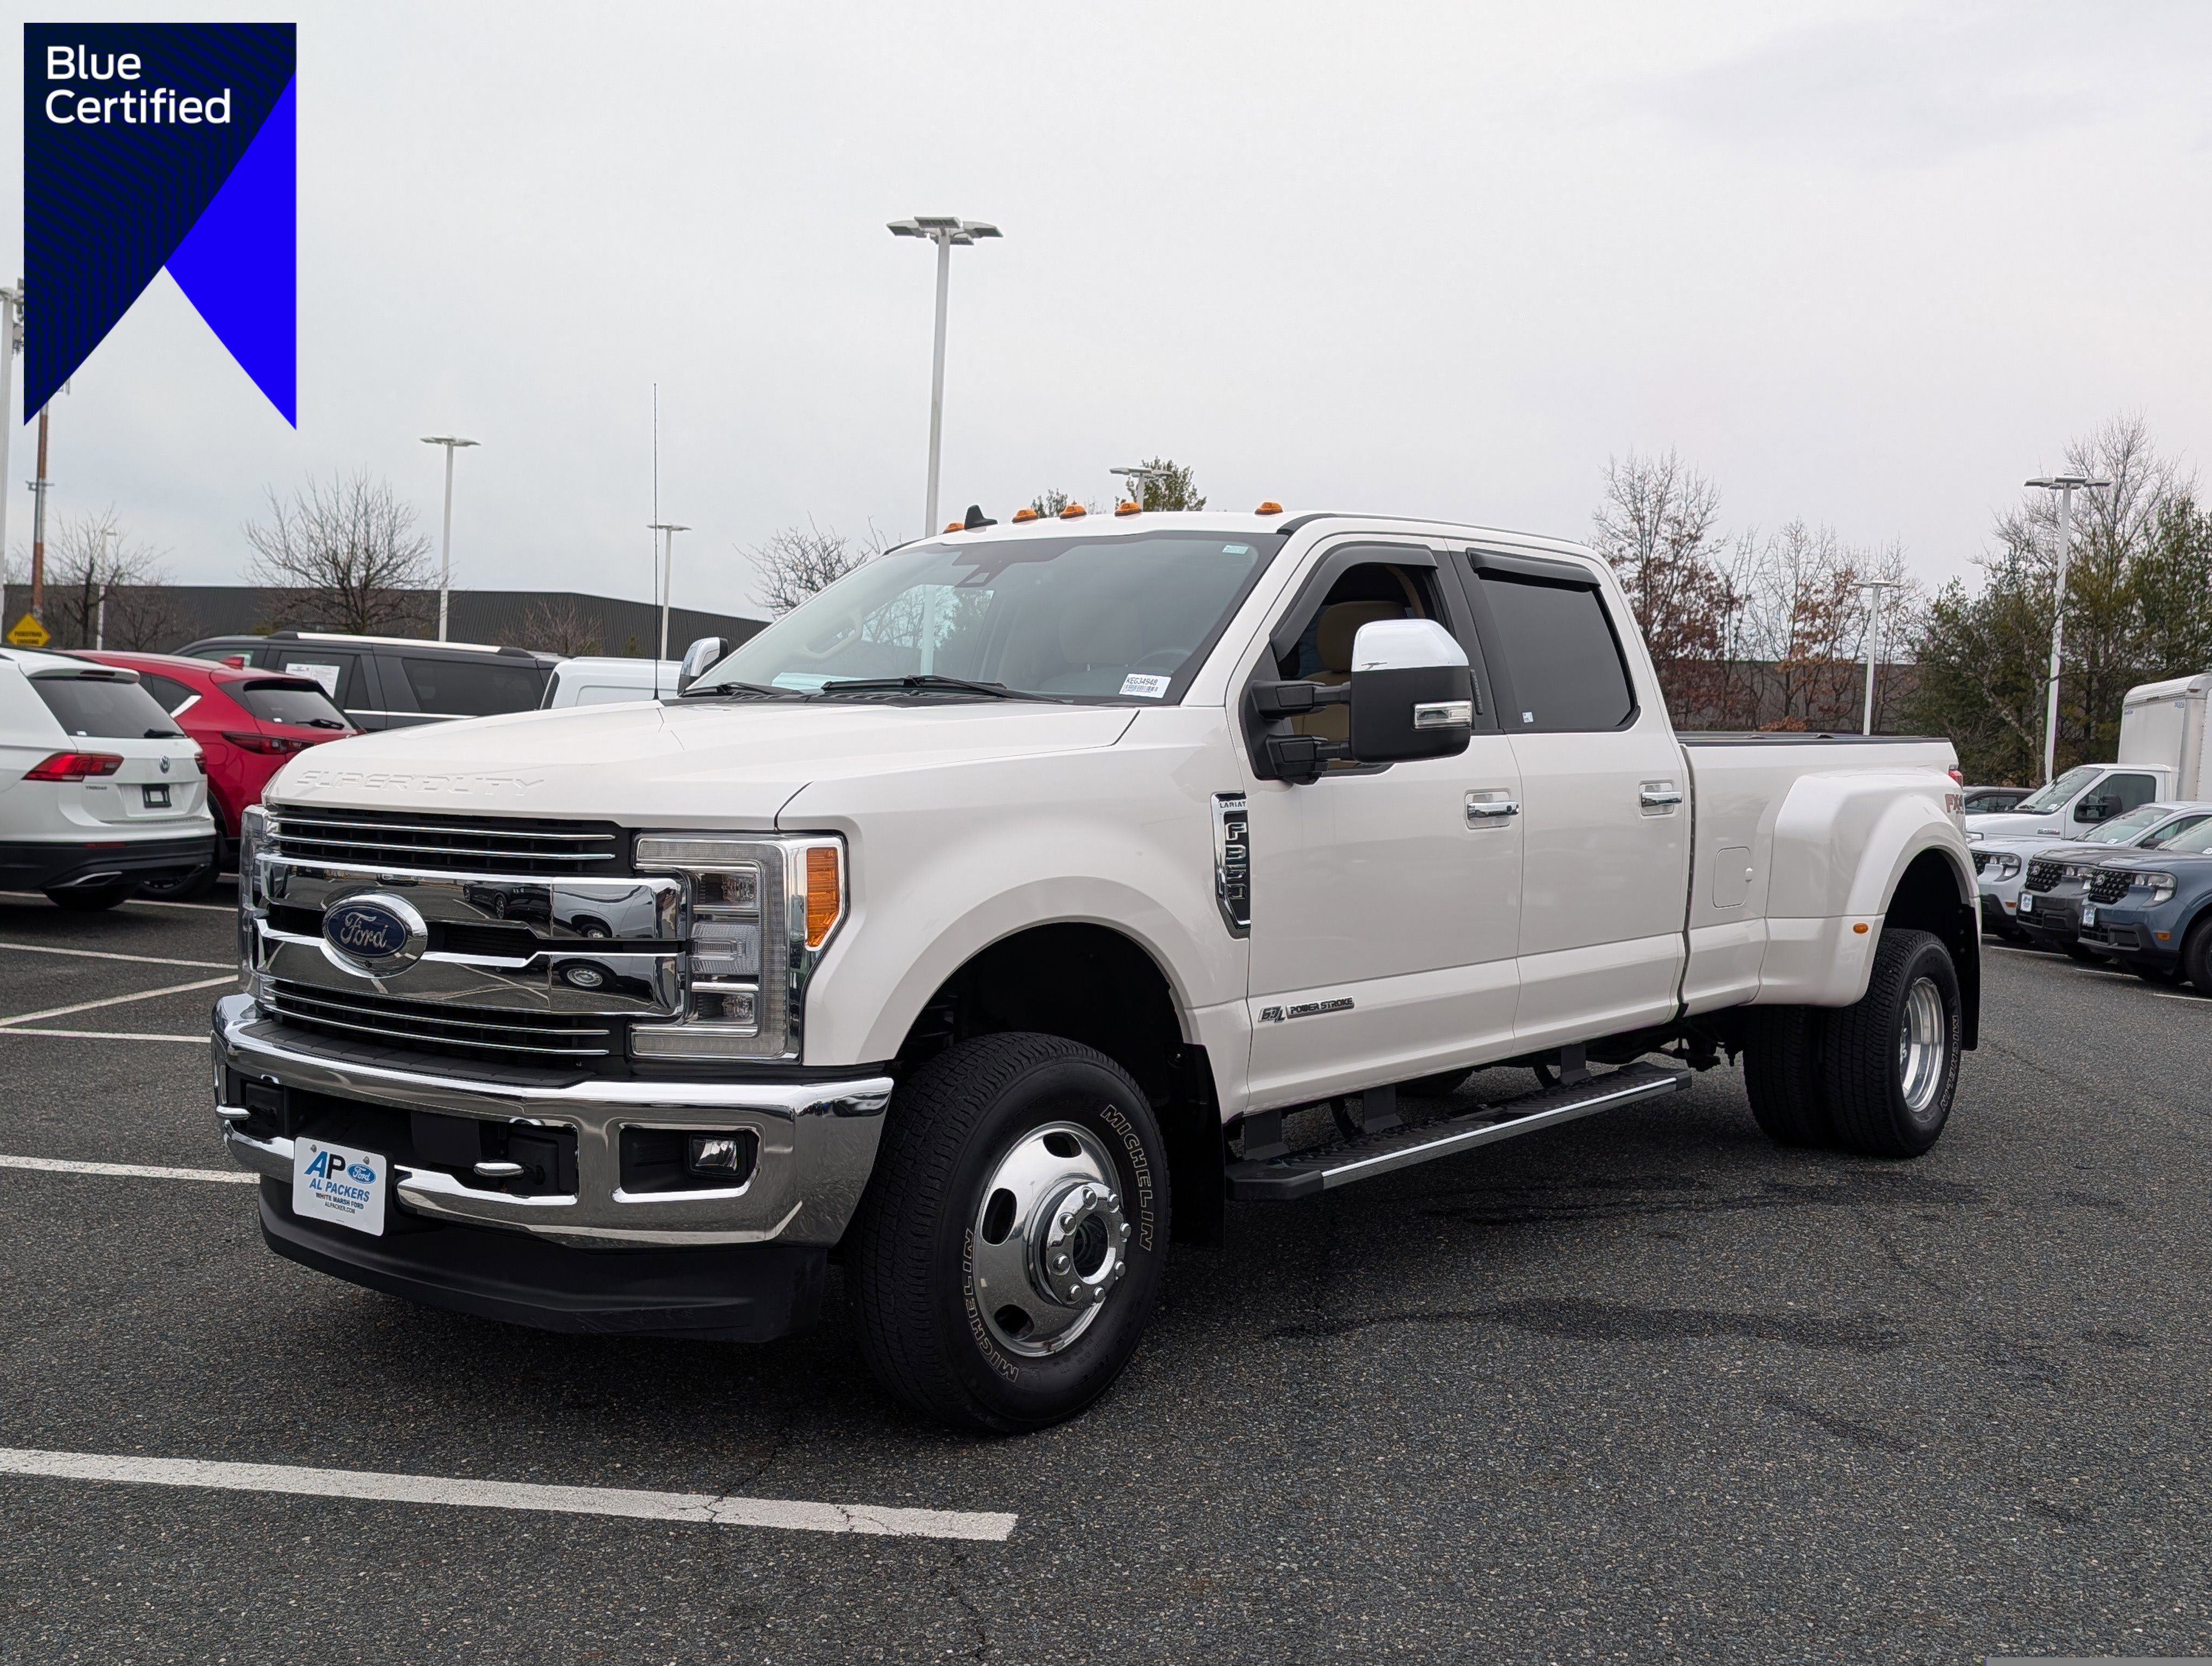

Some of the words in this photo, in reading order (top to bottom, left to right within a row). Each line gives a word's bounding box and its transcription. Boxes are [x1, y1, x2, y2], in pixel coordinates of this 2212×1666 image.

[294, 770, 415, 792] SUPER
[416, 775, 545, 796] DUTY
[340, 912, 389, 949] Ford
[1290, 1002, 1320, 1015] POWER
[1321, 997, 1354, 1009] STROKE
[1940, 1015, 1960, 1112] MICHELIN
[304, 1151, 346, 1180] AP
[352, 1166, 371, 1181] Ford
[1099, 1104, 1154, 1252] MICHELIN
[309, 1178, 322, 1190] AL
[325, 1181, 370, 1202] PACKERS
[316, 1192, 332, 1201] WHITE
[333, 1196, 350, 1206] MARSH
[351, 1201, 364, 1209] FORD
[962, 1227, 1019, 1383] MICHELIN
